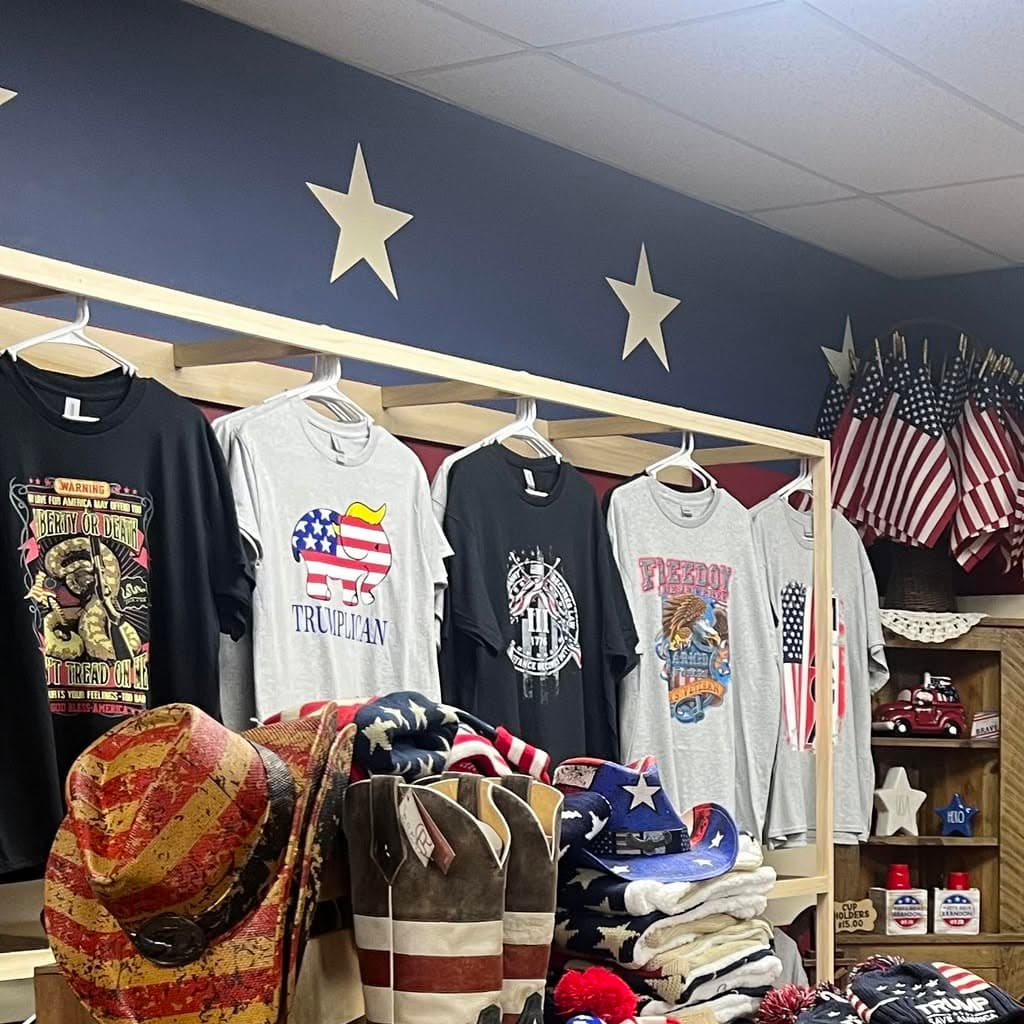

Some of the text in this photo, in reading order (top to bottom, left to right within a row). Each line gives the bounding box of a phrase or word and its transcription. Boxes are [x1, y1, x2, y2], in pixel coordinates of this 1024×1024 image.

[59, 482, 105, 494] WARNING
[62, 497, 92, 508] AMERICA
[81, 512, 100, 536] OR
[291, 603, 389, 647] TRUMPLICAN
[65, 661, 111, 687] TREAD
[114, 658, 132, 688] ON
[842, 903, 858, 912] CUP
[914, 996, 990, 1016] TRUMP
[956, 1012, 999, 1024] AMERICA
